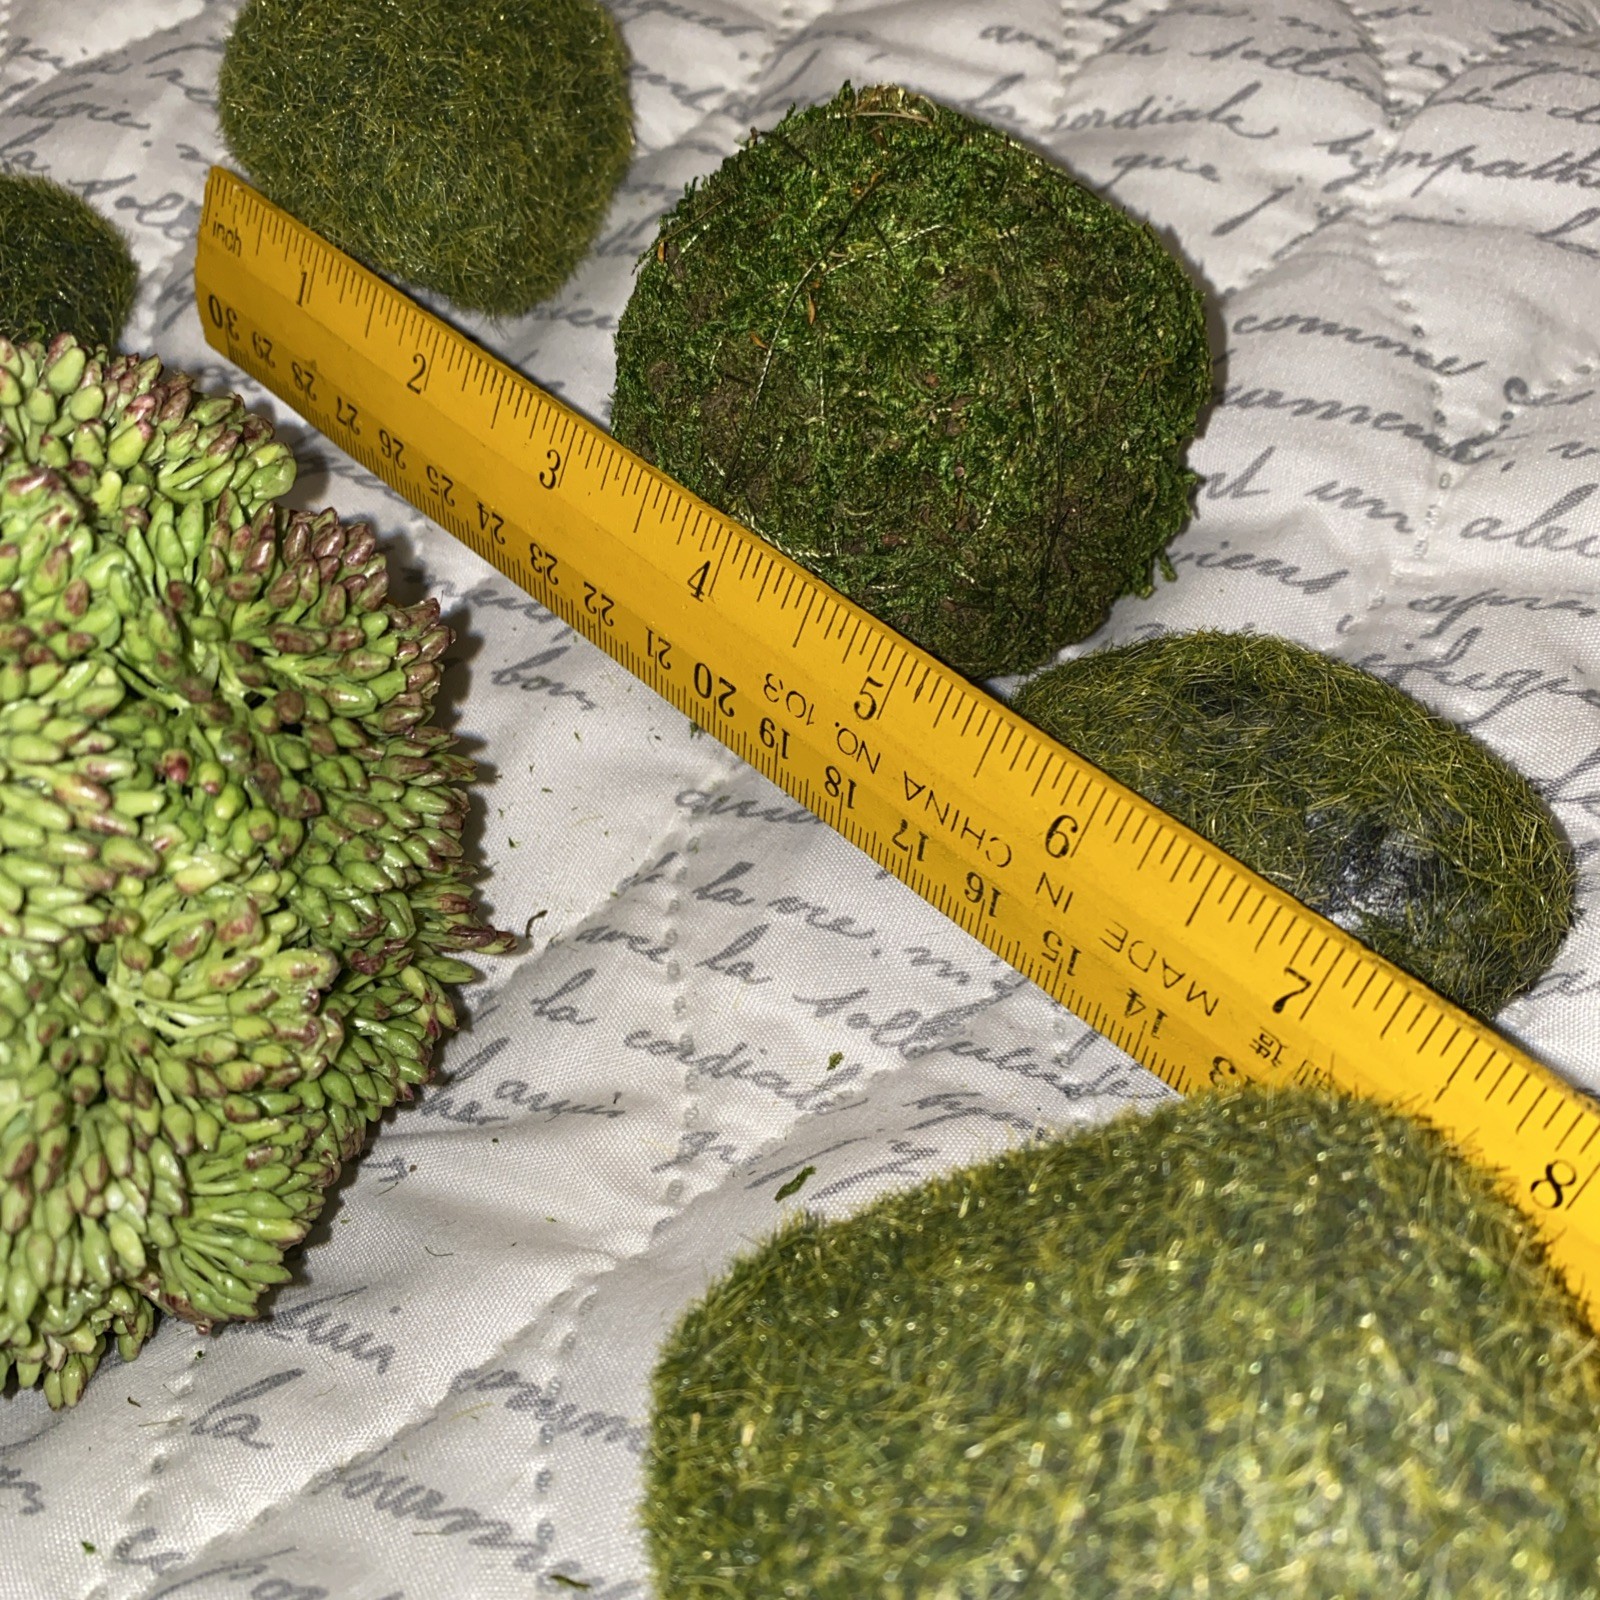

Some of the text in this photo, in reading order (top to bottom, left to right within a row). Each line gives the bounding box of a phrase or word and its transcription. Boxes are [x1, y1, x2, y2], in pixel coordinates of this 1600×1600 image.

[211, 212, 243, 259] inch
[295, 270, 309, 308] 1
[206, 293, 241, 343] 30
[251, 330, 276, 370] 29
[291, 360, 319, 402] 28
[405, 352, 428, 396] 2
[335, 395, 362, 437] 27
[378, 428, 408, 471] 26
[538, 448, 562, 491] 3
[425, 463, 456, 508] 25
[475, 500, 508, 546] 24
[528, 541, 560, 587] 23
[686, 559, 712, 604] 4
[582, 580, 616, 628] 22
[644, 625, 673, 671] 21
[692, 661, 738, 719] 20
[853, 675, 885, 722] 5
[758, 716, 792, 761] 19
[762, 671, 882, 776] NO. 103
[823, 764, 858, 811] 18
[890, 817, 931, 863] 17
[1044, 813, 1079, 860] 6
[903, 769, 1220, 1018] MADE IN CHINA
[963, 870, 1003, 919] 16
[1040, 929, 1083, 977] 15
[1271, 965, 1312, 1015] 7
[1123, 987, 1170, 1041] 14
[1529, 1158, 1578, 1211] 8
